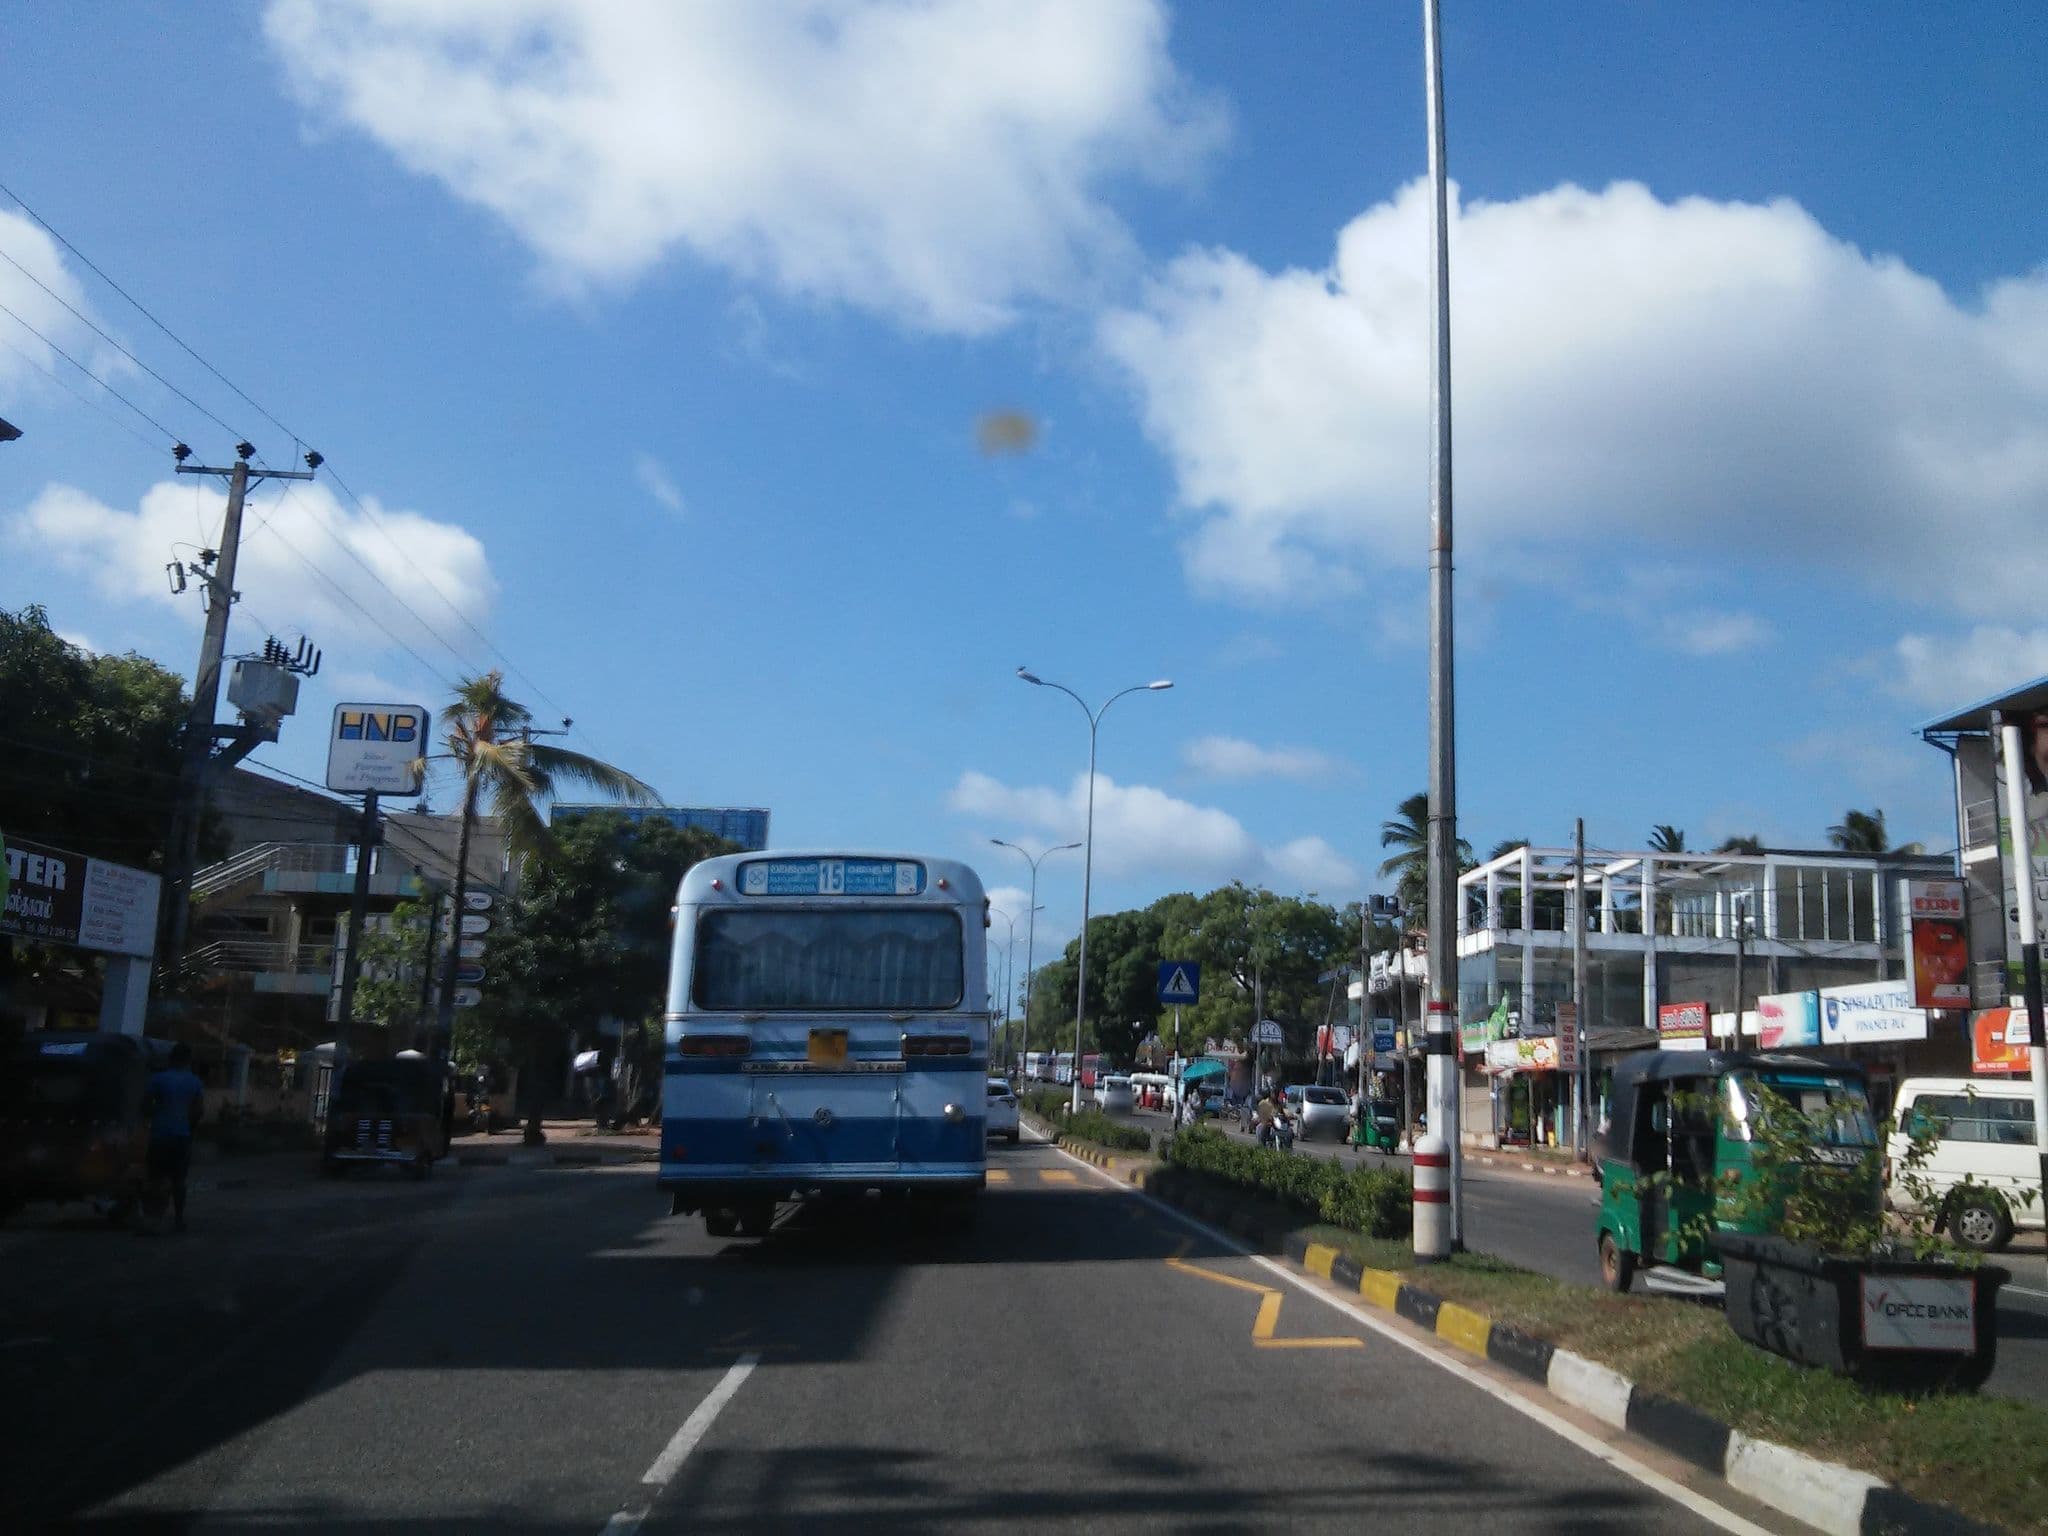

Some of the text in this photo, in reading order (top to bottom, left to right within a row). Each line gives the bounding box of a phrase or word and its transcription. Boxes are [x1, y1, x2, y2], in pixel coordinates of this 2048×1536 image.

[339, 711, 416, 742] HNB
[821, 863, 844, 891] 15
[1914, 897, 1960, 911] EXIDE
[1928, 1304, 1968, 1319] BANK
